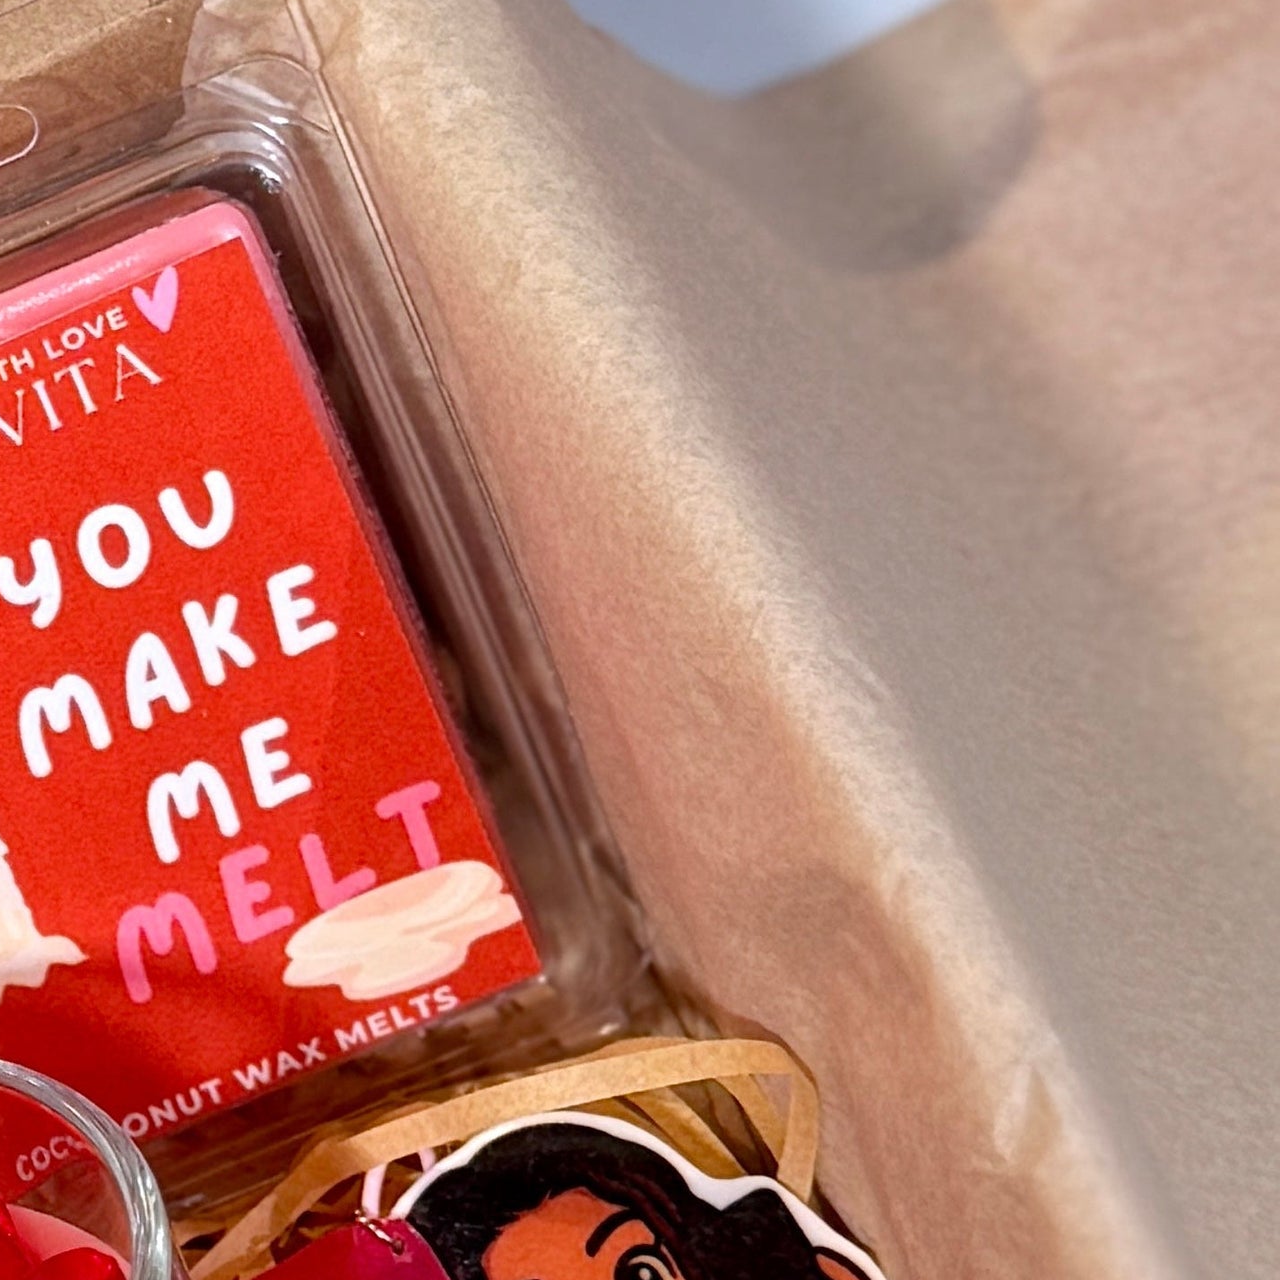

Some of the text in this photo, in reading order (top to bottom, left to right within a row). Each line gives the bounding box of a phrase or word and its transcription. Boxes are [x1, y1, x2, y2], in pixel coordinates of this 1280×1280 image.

[43, 305, 129, 361] LOVE
[17, 563, 338, 779] MAKE
[146, 717, 312, 864] ME
[116, 780, 450, 1004] MELT
[233, 1036, 328, 1093] WAX
[332, 983, 461, 1053] MELTS
